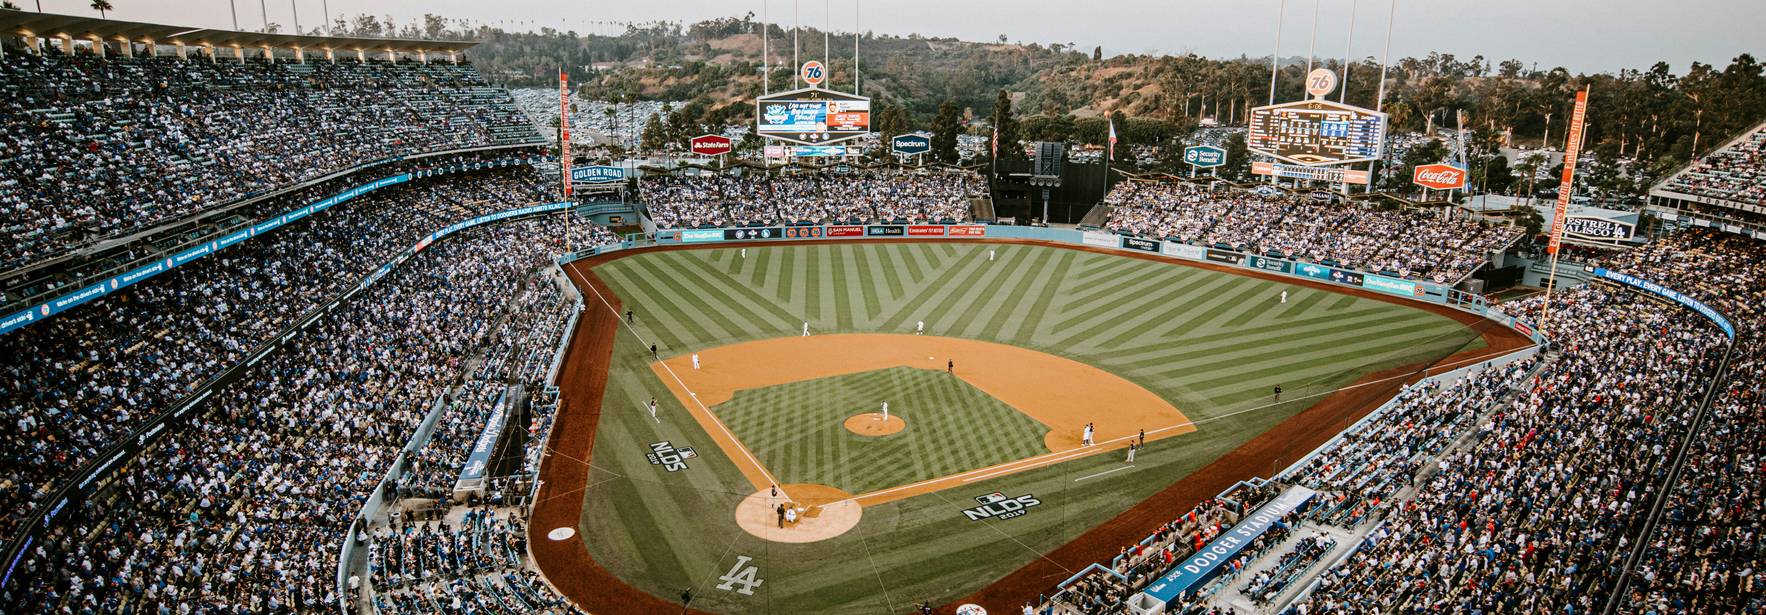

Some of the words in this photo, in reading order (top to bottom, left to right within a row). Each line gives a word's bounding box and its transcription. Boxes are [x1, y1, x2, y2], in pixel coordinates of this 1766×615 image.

[807, 66, 822, 79] 76
[1311, 76, 1329, 89] 76
[895, 140, 926, 148] Spectrum
[1565, 133, 1578, 169] Emirates
[574, 168, 601, 179] GOLDEN
[603, 168, 622, 178] ROAD
[497, 210, 518, 219] DODGERS
[1549, 212, 1562, 247] Emirates
[1562, 224, 1610, 237] JALISCO
[1129, 239, 1153, 247] Spectrum
[1606, 270, 1625, 283] EVERY
[1626, 276, 1643, 288] PLAY.
[1643, 281, 1662, 294] EVERY
[651, 441, 688, 472] NLDS
[963, 494, 1041, 521] NLDS
[1000, 509, 1026, 520] 2019
[1184, 536, 1242, 575] DODGER
[1236, 501, 1290, 537] STADIUM
[715, 555, 765, 597] LA
